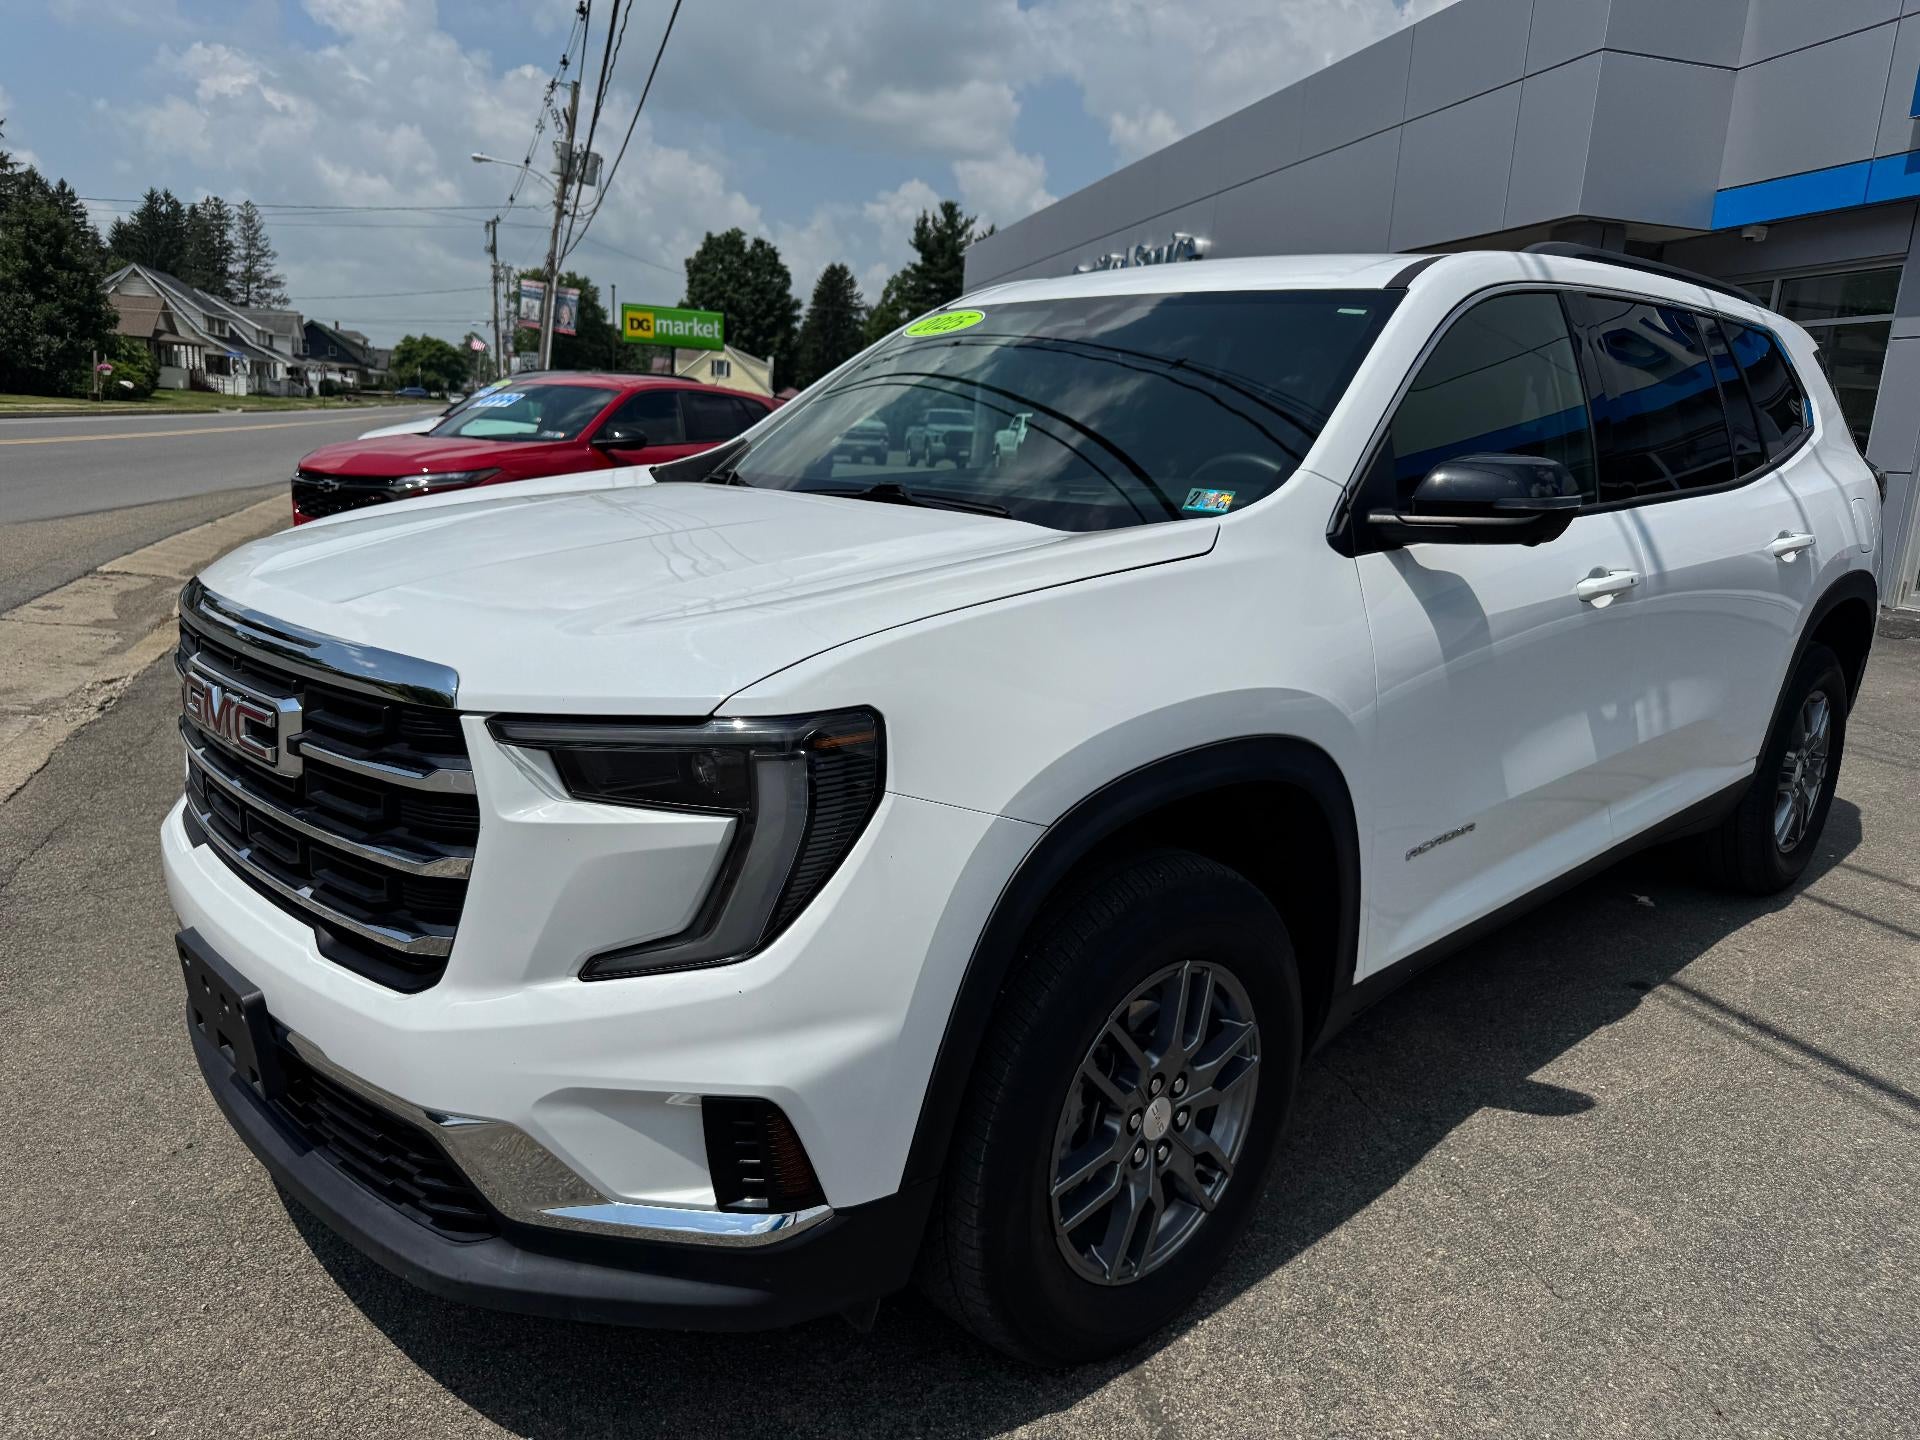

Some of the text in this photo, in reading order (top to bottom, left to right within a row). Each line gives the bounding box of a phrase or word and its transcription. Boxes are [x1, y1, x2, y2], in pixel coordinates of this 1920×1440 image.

[629, 317, 721, 339] DG market
[184, 671, 276, 763] GMC
[1405, 822, 1476, 861] ACADIA
